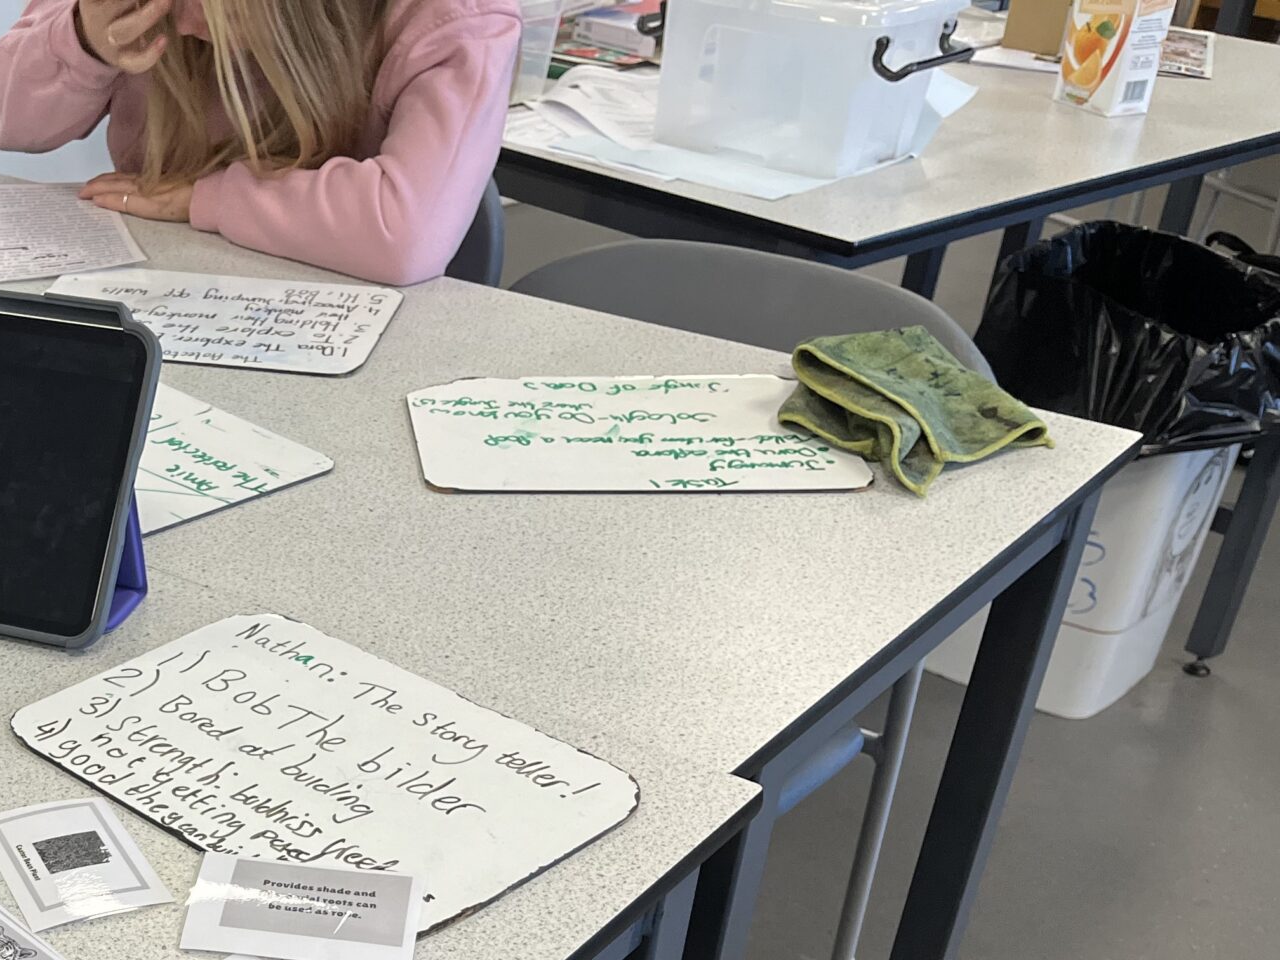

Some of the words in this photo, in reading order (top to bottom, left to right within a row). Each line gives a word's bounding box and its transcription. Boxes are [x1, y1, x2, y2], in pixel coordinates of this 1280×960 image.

[297, 344, 334, 357] Dora
[158, 694, 244, 742] Bored
[202, 669, 281, 716] Bob
[277, 704, 347, 753] The
[353, 682, 404, 715] The
[412, 712, 489, 765] story
[48, 740, 136, 786] good
[262, 879, 314, 892] Provides
[317, 886, 352, 896] shade
[353, 890, 377, 899] and
[322, 898, 353, 907] roots
